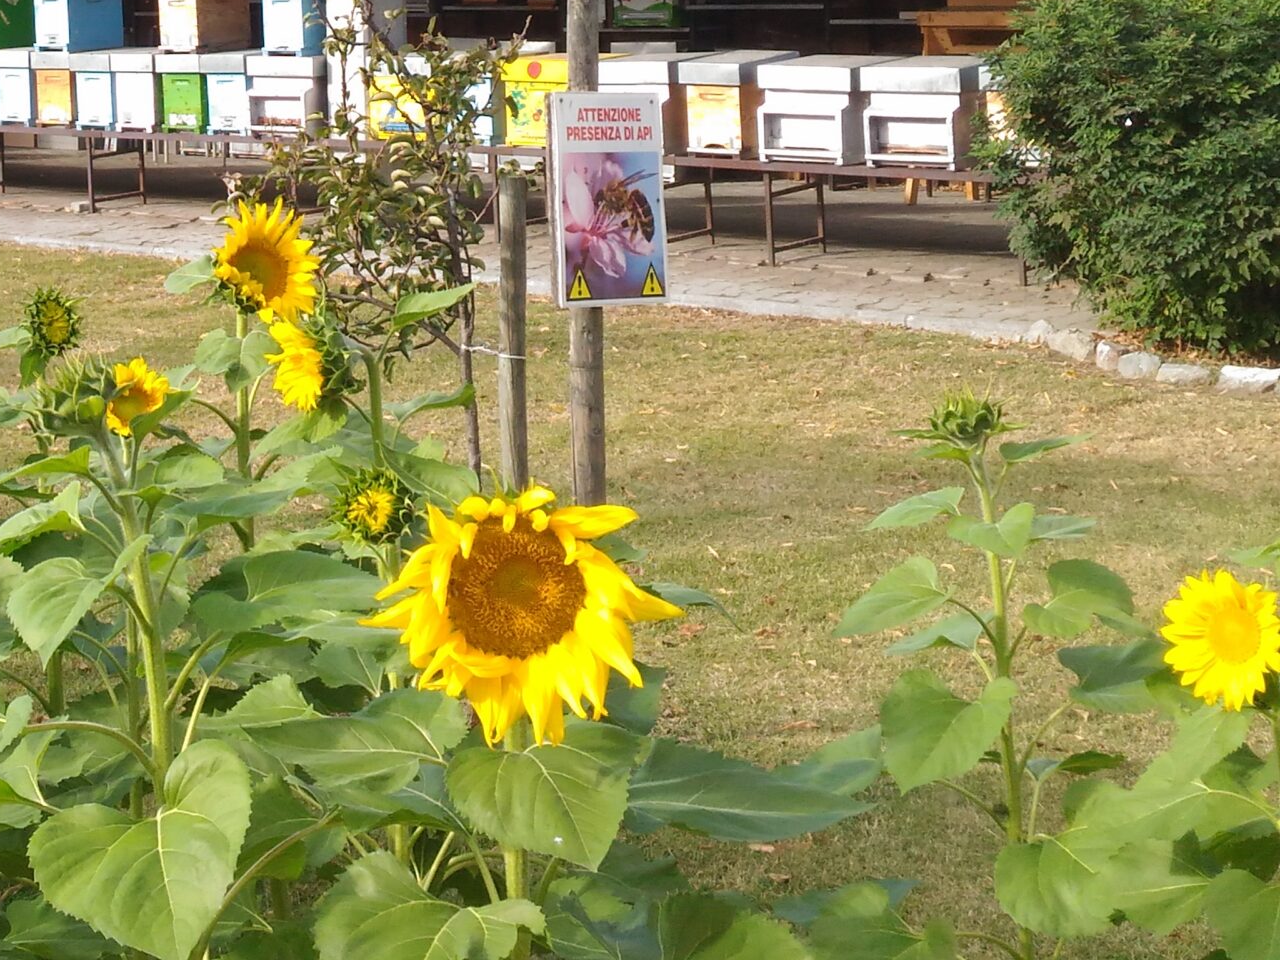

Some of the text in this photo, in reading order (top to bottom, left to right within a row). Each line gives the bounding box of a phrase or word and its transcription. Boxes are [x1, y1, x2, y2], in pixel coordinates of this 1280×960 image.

[577, 107, 642, 122] ATTENZIONE
[566, 125, 653, 141] PRESENZA DI API
